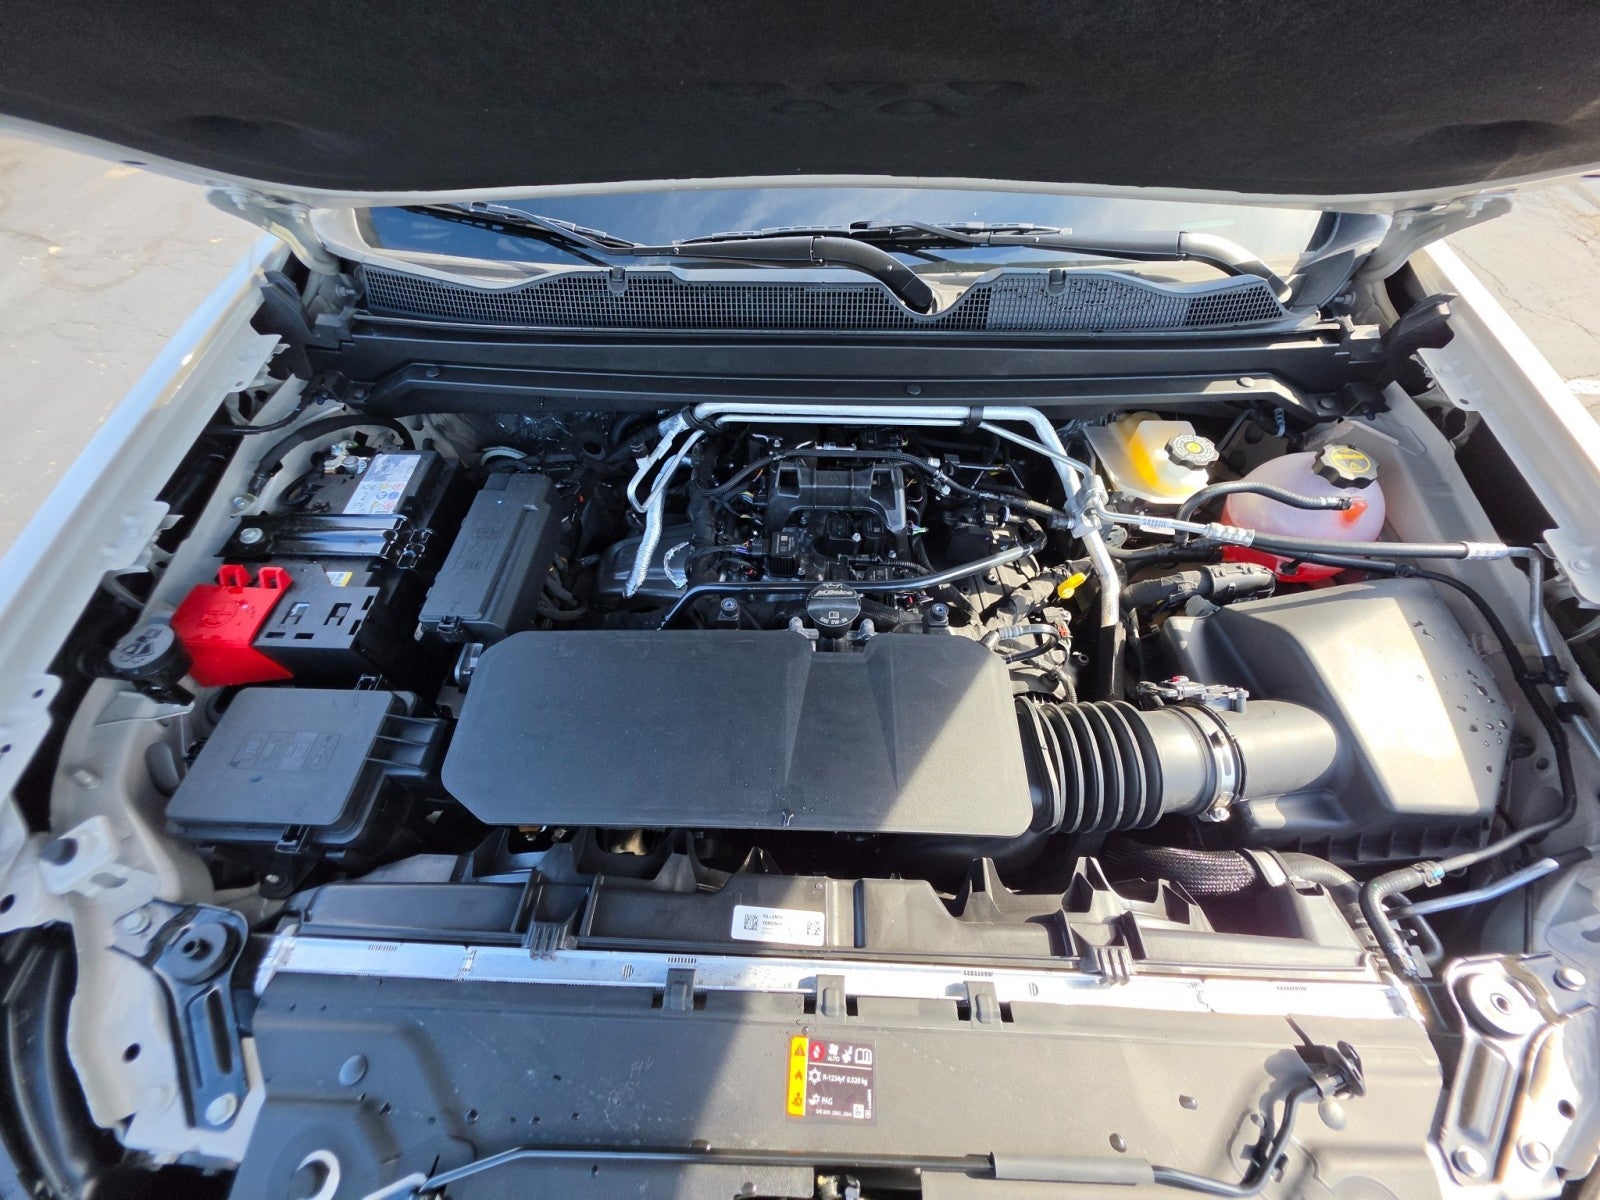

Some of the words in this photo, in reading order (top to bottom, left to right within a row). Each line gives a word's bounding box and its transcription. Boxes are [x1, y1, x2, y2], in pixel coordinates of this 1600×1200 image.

[822, 1074, 845, 1083] R-1234yf
[846, 1076, 861, 1084] 0.520
[821, 1097, 833, 1105] PAG
